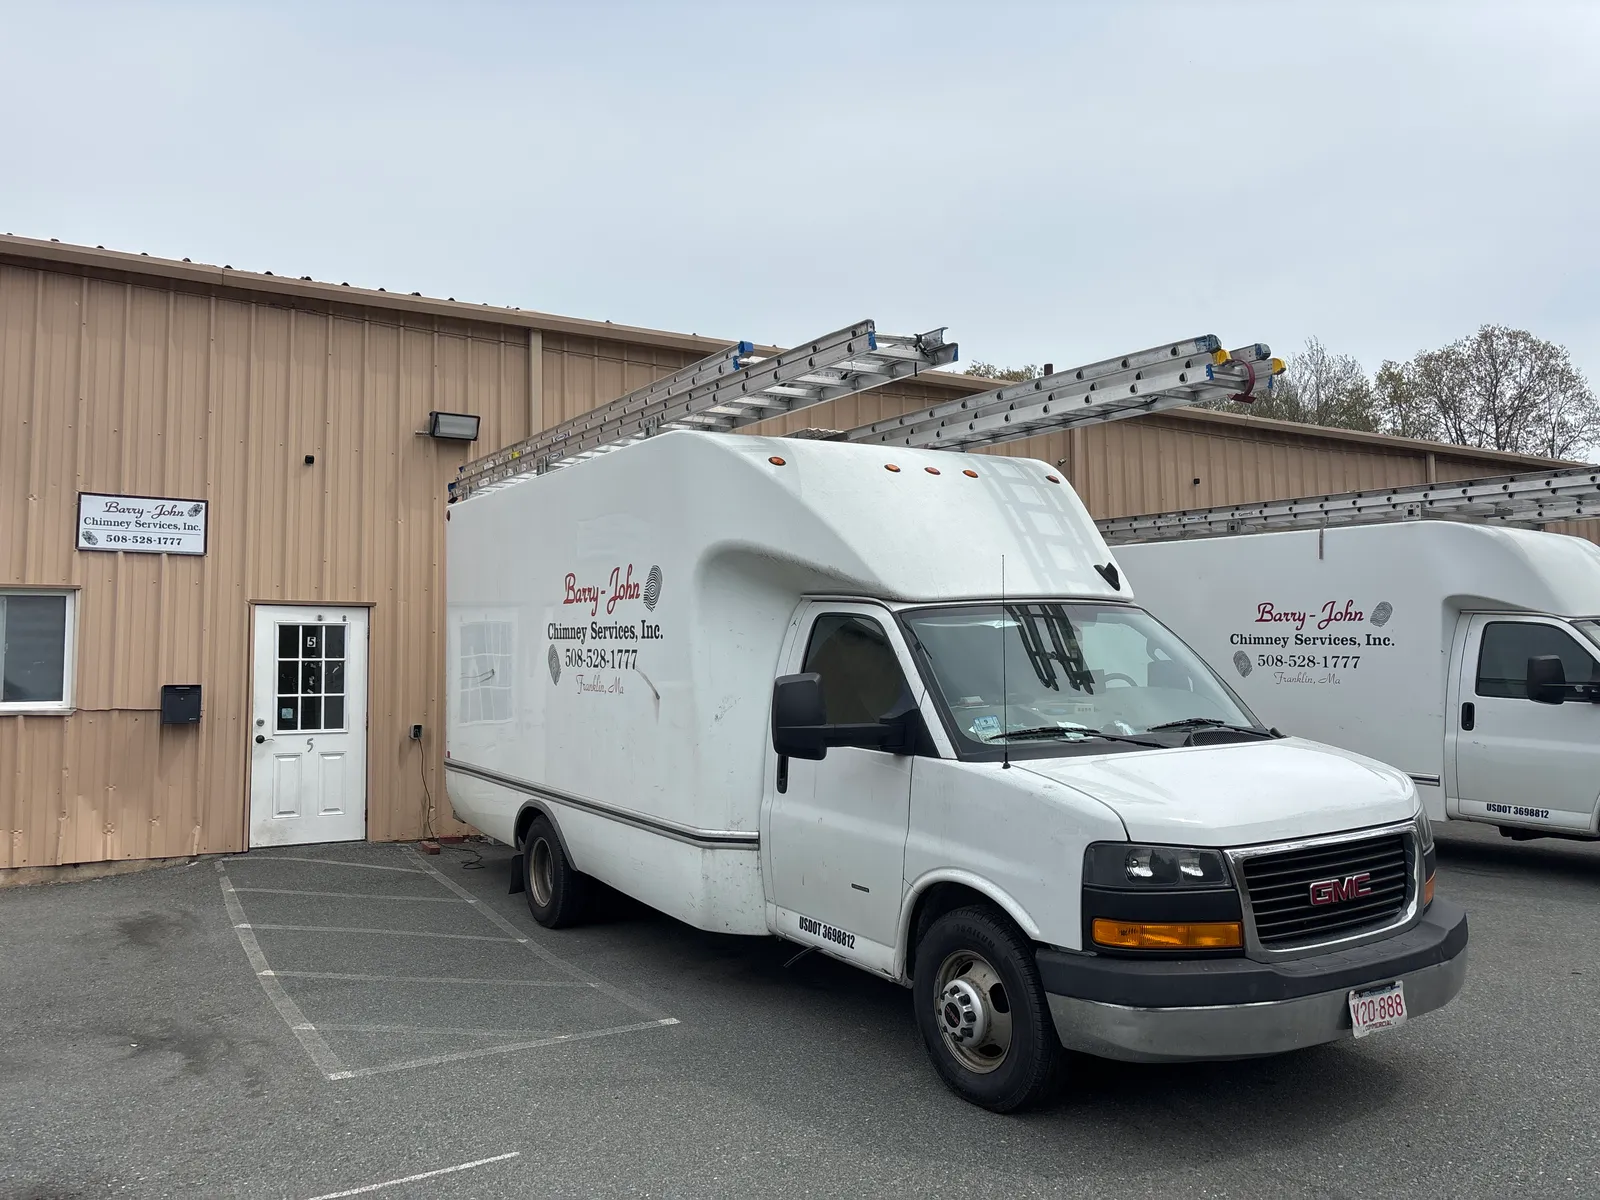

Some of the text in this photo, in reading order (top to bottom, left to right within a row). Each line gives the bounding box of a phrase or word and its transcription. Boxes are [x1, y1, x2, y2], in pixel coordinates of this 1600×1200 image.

[84, 516, 201, 531] Chimney Services, Inc.
[106, 534, 182, 546] 508-528-1777
[548, 620, 663, 645] Chimney Services, Inc.
[308, 637, 315, 646] 5
[1230, 633, 1395, 648] Chimney Services, Inc.
[565, 648, 638, 670] 508-528-1777
[1257, 654, 1361, 669] 508-528-1777
[1273, 671, 1316, 685] Franklin,
[306, 738, 314, 753] 5
[1486, 803, 1549, 819] USDOT 3698812
[1309, 872, 1372, 906] GMC
[799, 915, 856, 949] USDOT 3698812
